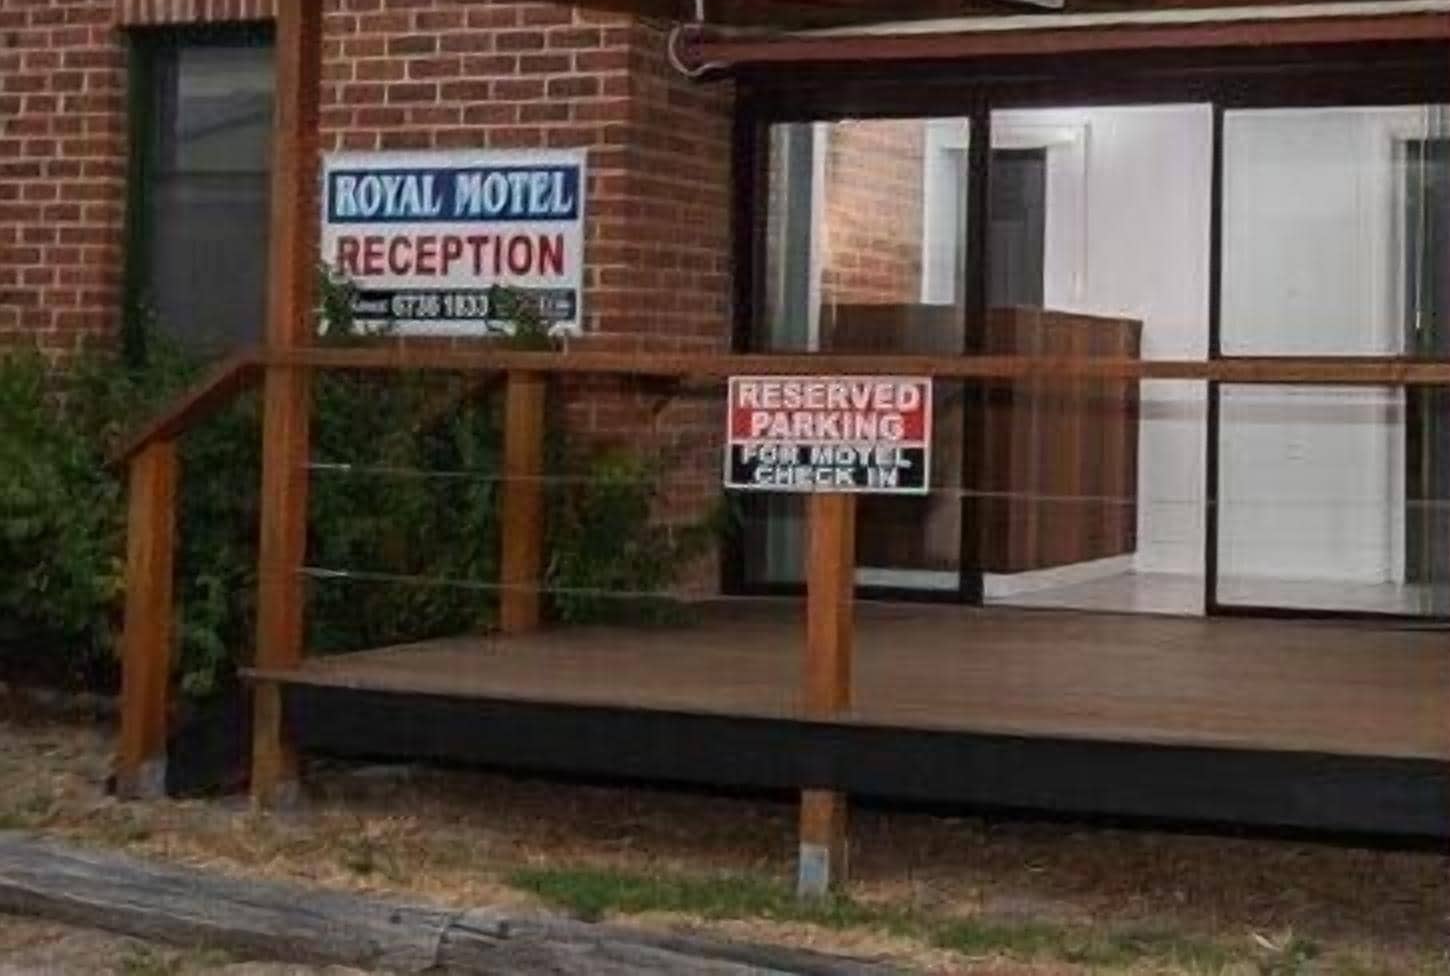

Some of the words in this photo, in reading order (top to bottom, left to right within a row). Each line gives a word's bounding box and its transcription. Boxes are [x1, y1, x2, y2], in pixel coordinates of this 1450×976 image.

[335, 175, 442, 217] ROYAL
[455, 171, 573, 215] MOTEL
[336, 234, 565, 276] RECEPTION
[738, 382, 921, 411] RESERVED
[750, 410, 905, 440] PARKING
[740, 444, 799, 465] FOR
[810, 444, 913, 467] MOTEL
[754, 467, 856, 486] CHECK
[867, 467, 899, 488] IN
